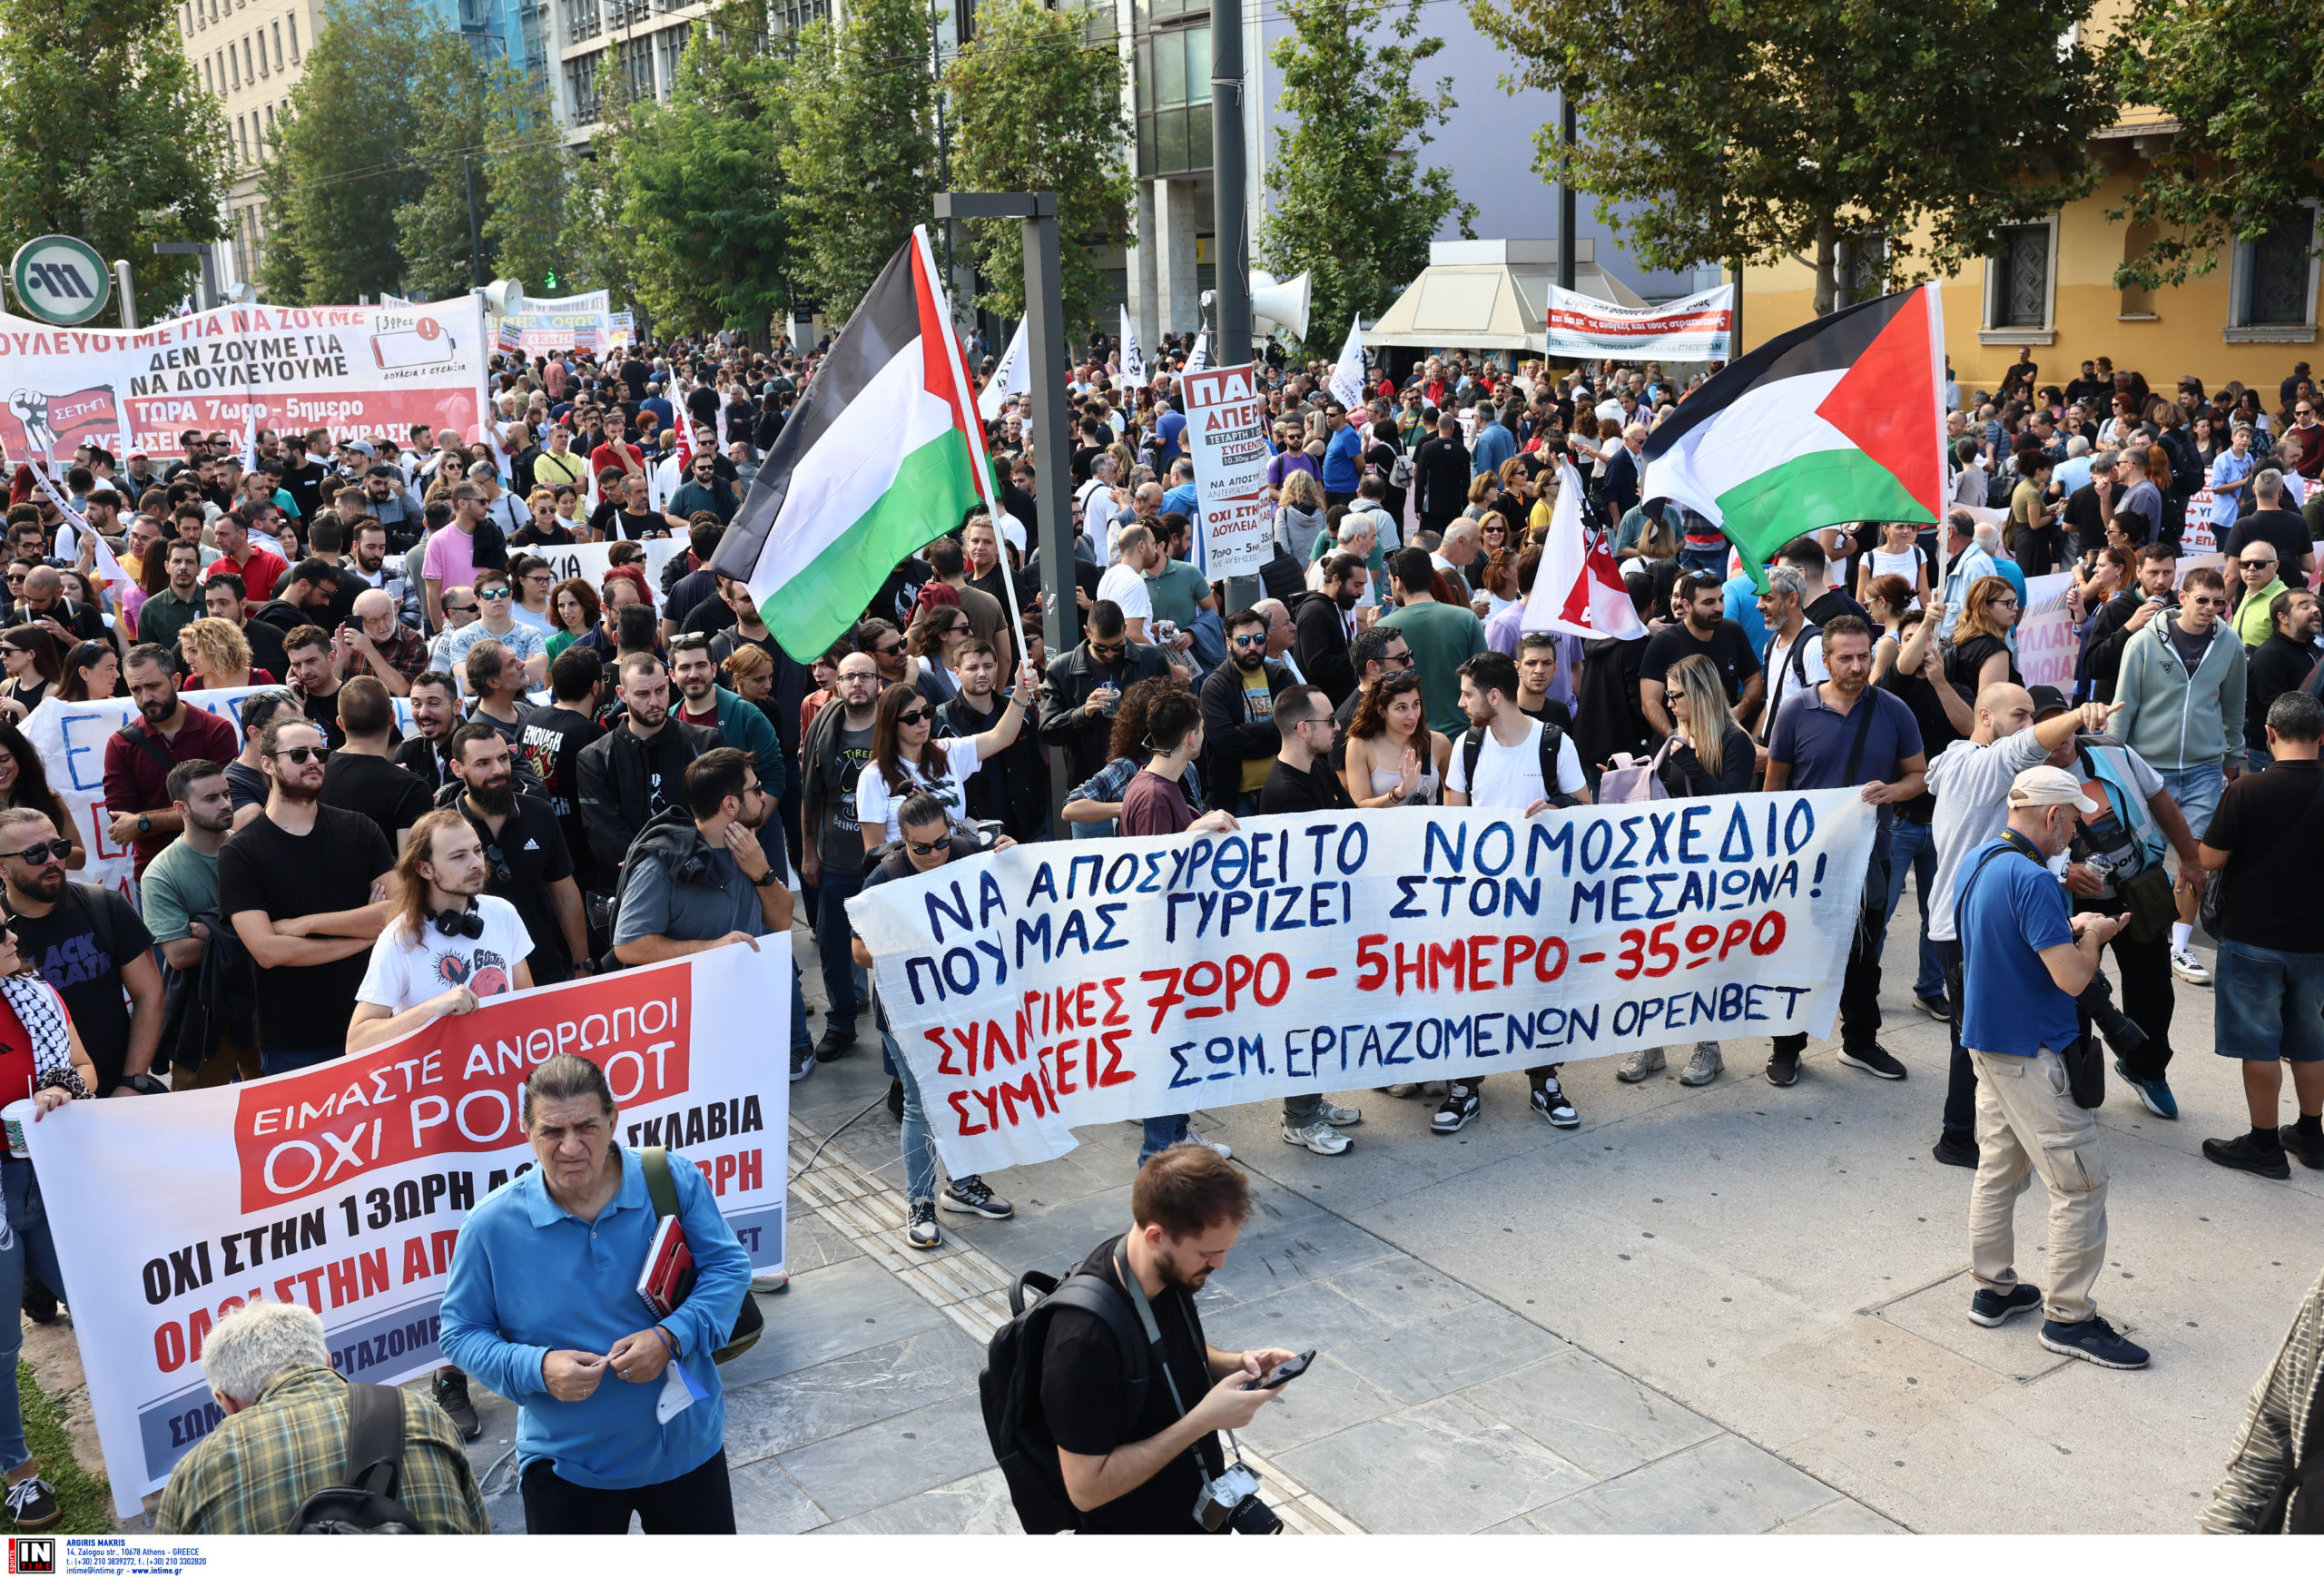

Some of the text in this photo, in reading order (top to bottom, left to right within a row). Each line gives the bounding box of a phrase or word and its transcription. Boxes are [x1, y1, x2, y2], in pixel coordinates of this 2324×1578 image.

[182, 315, 223, 340] ΓΙΑ
[231, 311, 271, 333] ΝΑ
[276, 309, 367, 330] ΖΟΥΜΕ
[150, 333, 344, 371] ΔΕΝ ΖΟΥΜΕ ΓΙΑ
[131, 356, 349, 397] ΝΑ ΔΟΥΛΕΥΟΥΜΕ
[135, 400, 198, 423] ΤΩΡΑ
[286, 398, 363, 423] 5ημερο
[327, 423, 412, 445] ΥΜΒΑΣΗ
[1209, 429, 1249, 444] ΤΕΤΑΡΤΗ
[1210, 479, 1225, 489] ΝΑ
[1208, 508, 1232, 524] ΟΧΙ
[1212, 518, 1258, 538] ΔΟΥΛΕΙΑ
[1210, 547, 1232, 559] 7ΩΡΟ
[522, 725, 564, 752] ENOUGH
[923, 797, 1816, 945] ΝΑ ΑΠΟΣΥΡΘΕΙ ΤΟ ΝΟΜΟΣΧΕΔΙΟ
[1166, 880, 1351, 943] ΓΥΡΙΖΕΙ
[1389, 875, 1541, 919] ΣΤΟΝ
[1139, 952, 1291, 1034] 7ΩΡΟ
[1355, 932, 1570, 997] 5ΗΜΕΡΟ
[1614, 909, 1787, 981] 35ΩΡΟ
[1285, 1002, 1600, 1080] ΕΡΓΑΖΟΜΕΝΩΝ
[253, 997, 678, 1137] ΕΙΜΑΣΤΕ ΑΝΘΡΩΠΟΙ
[263, 1119, 382, 1195] ΟΧΙ
[409, 1040, 677, 1149] ΡΟΟΤ
[143, 1240, 213, 1306] ΟΧΙ
[220, 1206, 327, 1277] ΣΤΗΝ
[340, 1170, 475, 1238] 13ΩΡΗ
